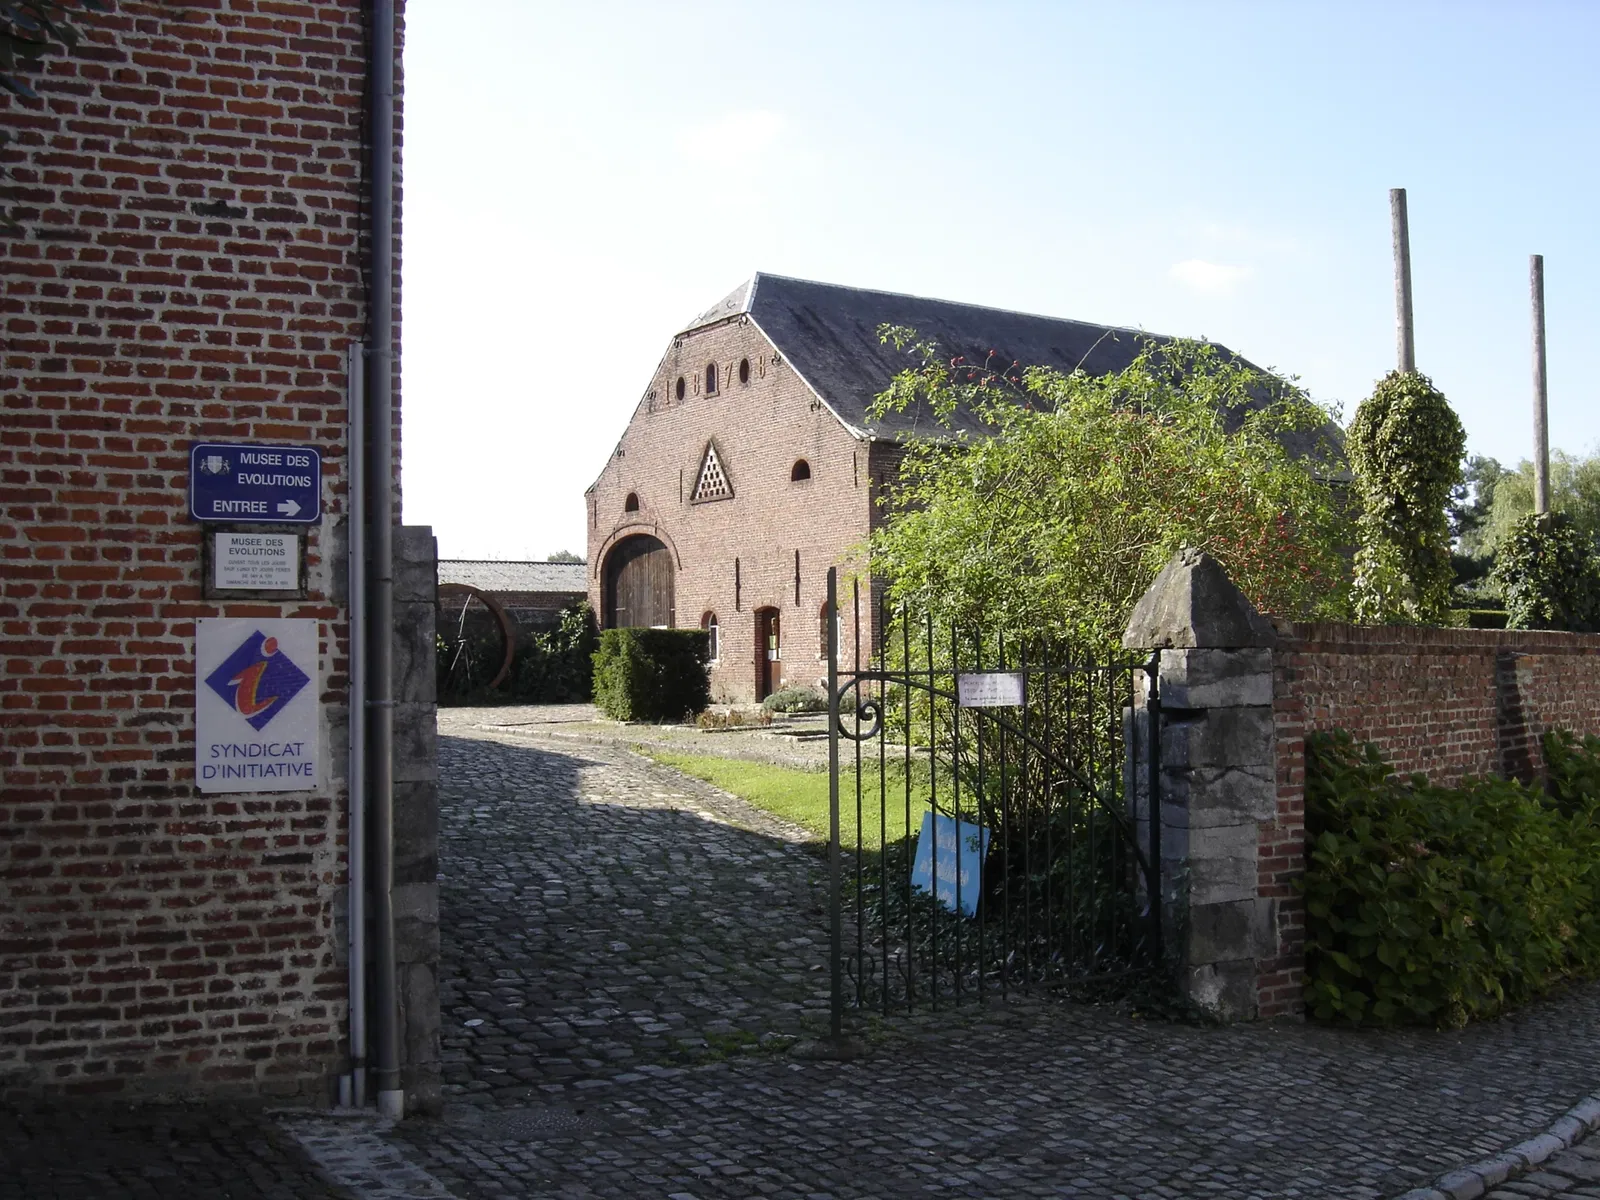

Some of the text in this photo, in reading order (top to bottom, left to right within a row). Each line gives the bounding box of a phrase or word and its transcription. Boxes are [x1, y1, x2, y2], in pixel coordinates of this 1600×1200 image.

[240, 452, 310, 467] MUSEE DES
[237, 473, 311, 488] EVOLUTIONS
[213, 500, 268, 513] ENTREE
[231, 537, 284, 547] MUSEE DES
[229, 547, 286, 556] EVOLUTIONS
[210, 742, 304, 758] SYNDICAT
[202, 762, 313, 779] D'INITIATIVE
